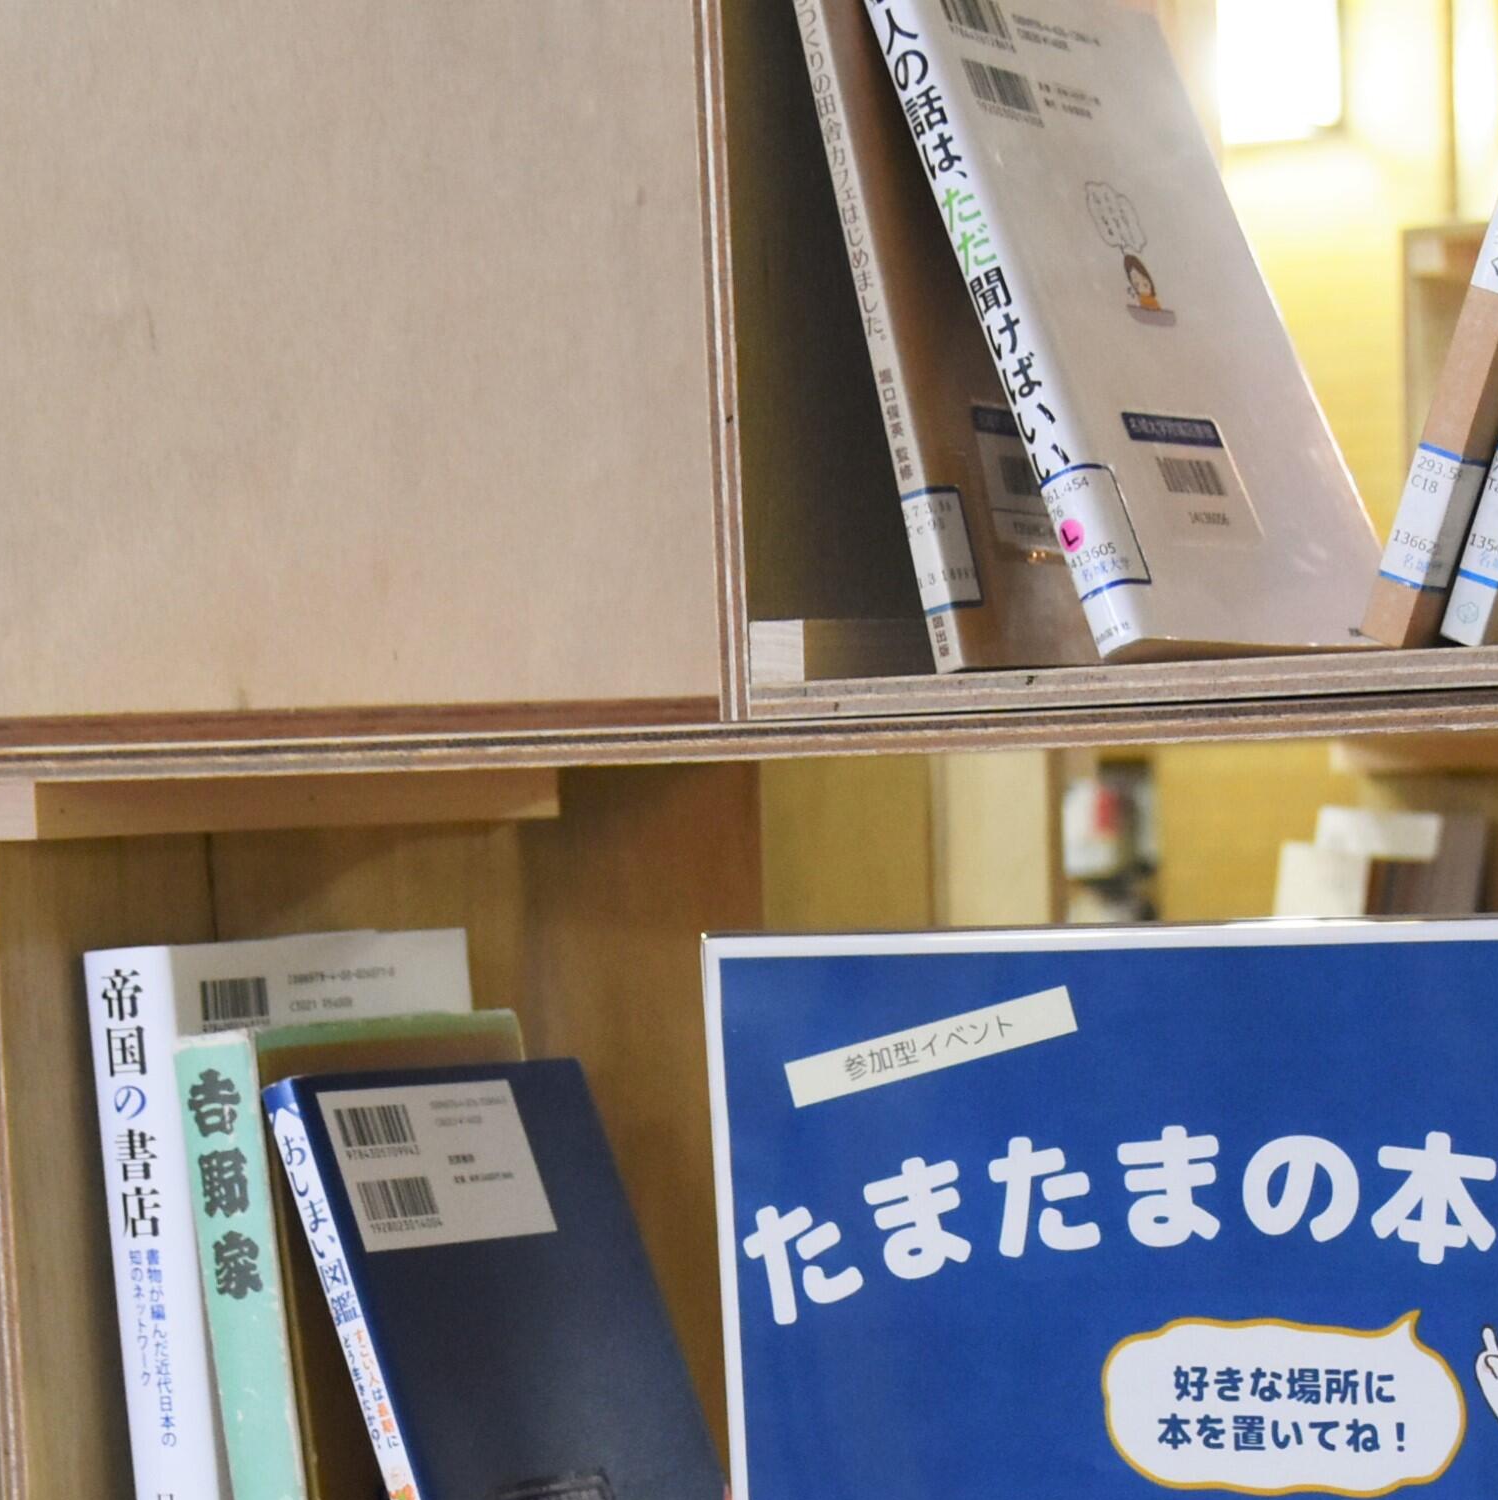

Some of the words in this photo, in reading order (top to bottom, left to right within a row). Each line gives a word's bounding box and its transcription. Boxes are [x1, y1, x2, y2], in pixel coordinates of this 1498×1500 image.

[1411, 474, 1438, 494] C18
[842, 1012, 1016, 1083] 参加型イベント
[100, 967, 162, 1240] 帝国の書店
[282, 1133, 363, 1328] おしまい図鑑
[128, 1249, 152, 1387] 知のネットワーク
[1172, 1363, 1398, 1407] 好きな場所に
[1156, 1408, 1408, 1456] 本を置いてね！
